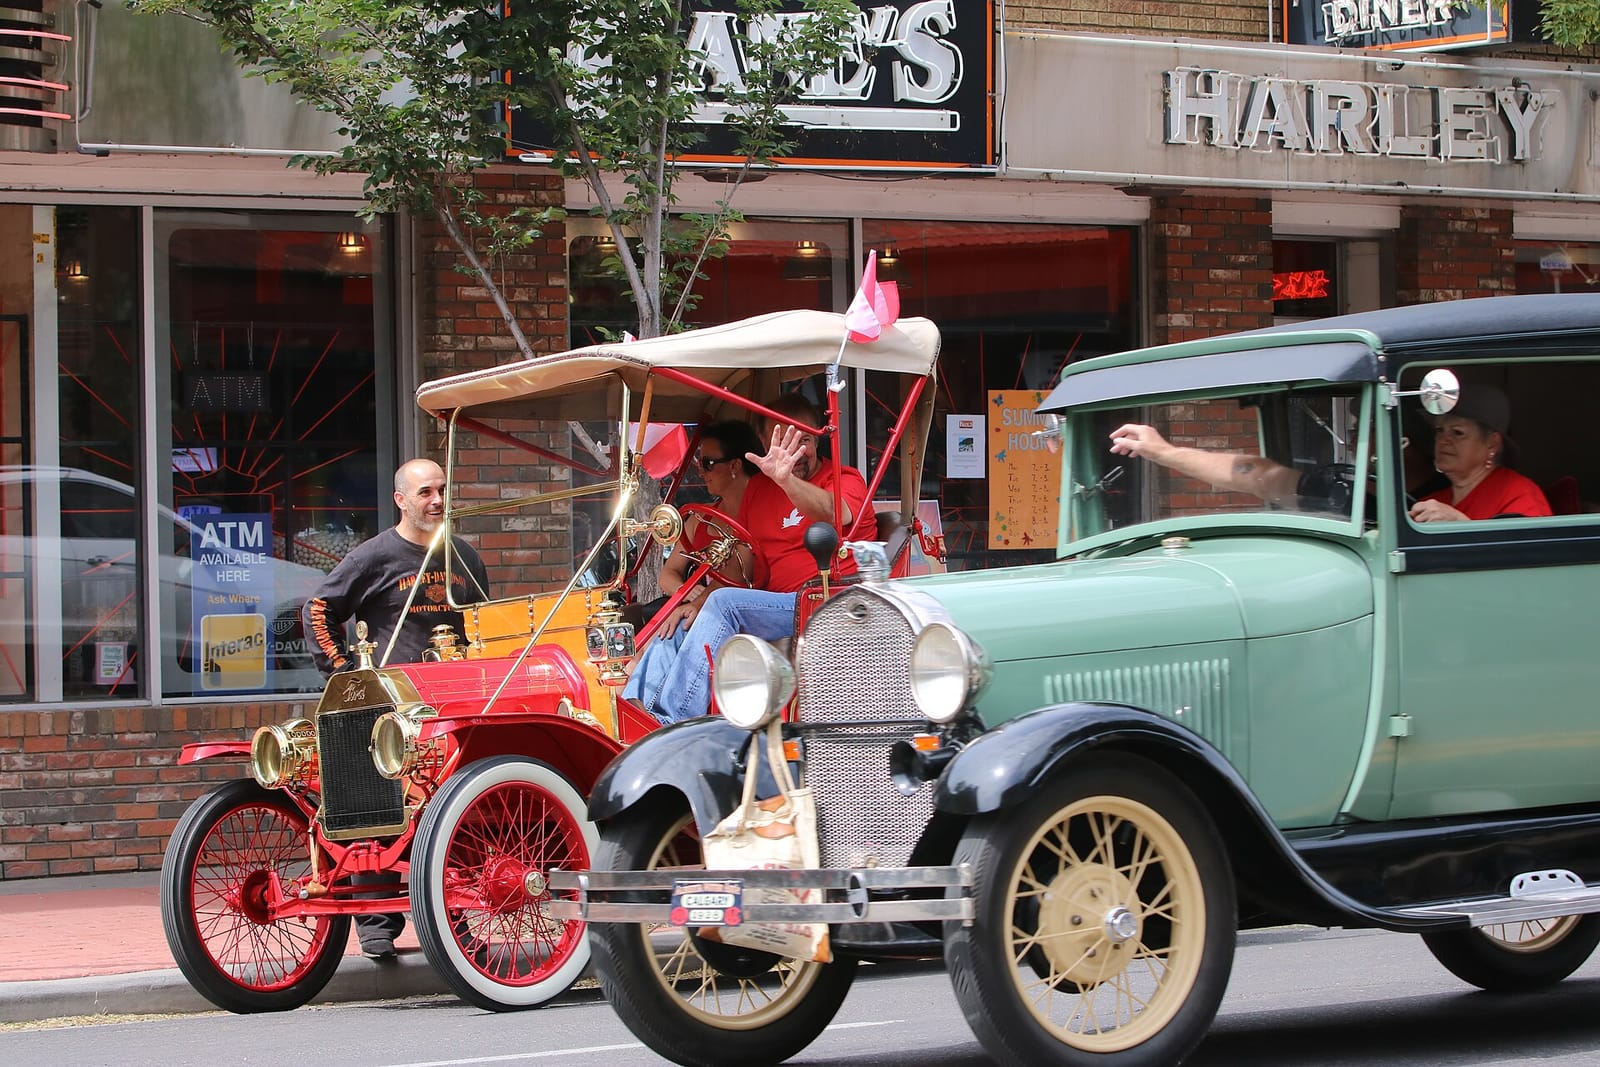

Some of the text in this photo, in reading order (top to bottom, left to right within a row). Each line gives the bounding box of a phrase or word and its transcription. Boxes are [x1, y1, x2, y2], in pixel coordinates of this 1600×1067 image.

[1322, 0, 1453, 40] DINER
[1164, 66, 1556, 164] HARLEY
[192, 376, 261, 407] ATM
[1002, 407, 1047, 427] SUMM
[200, 521, 264, 549] ATM
[200, 552, 266, 565] AVAILABLE
[216, 570, 251, 582] HERE
[208, 594, 260, 605] Ask Where
[204, 632, 264, 661] Interac
[686, 895, 728, 906] CALGARY
